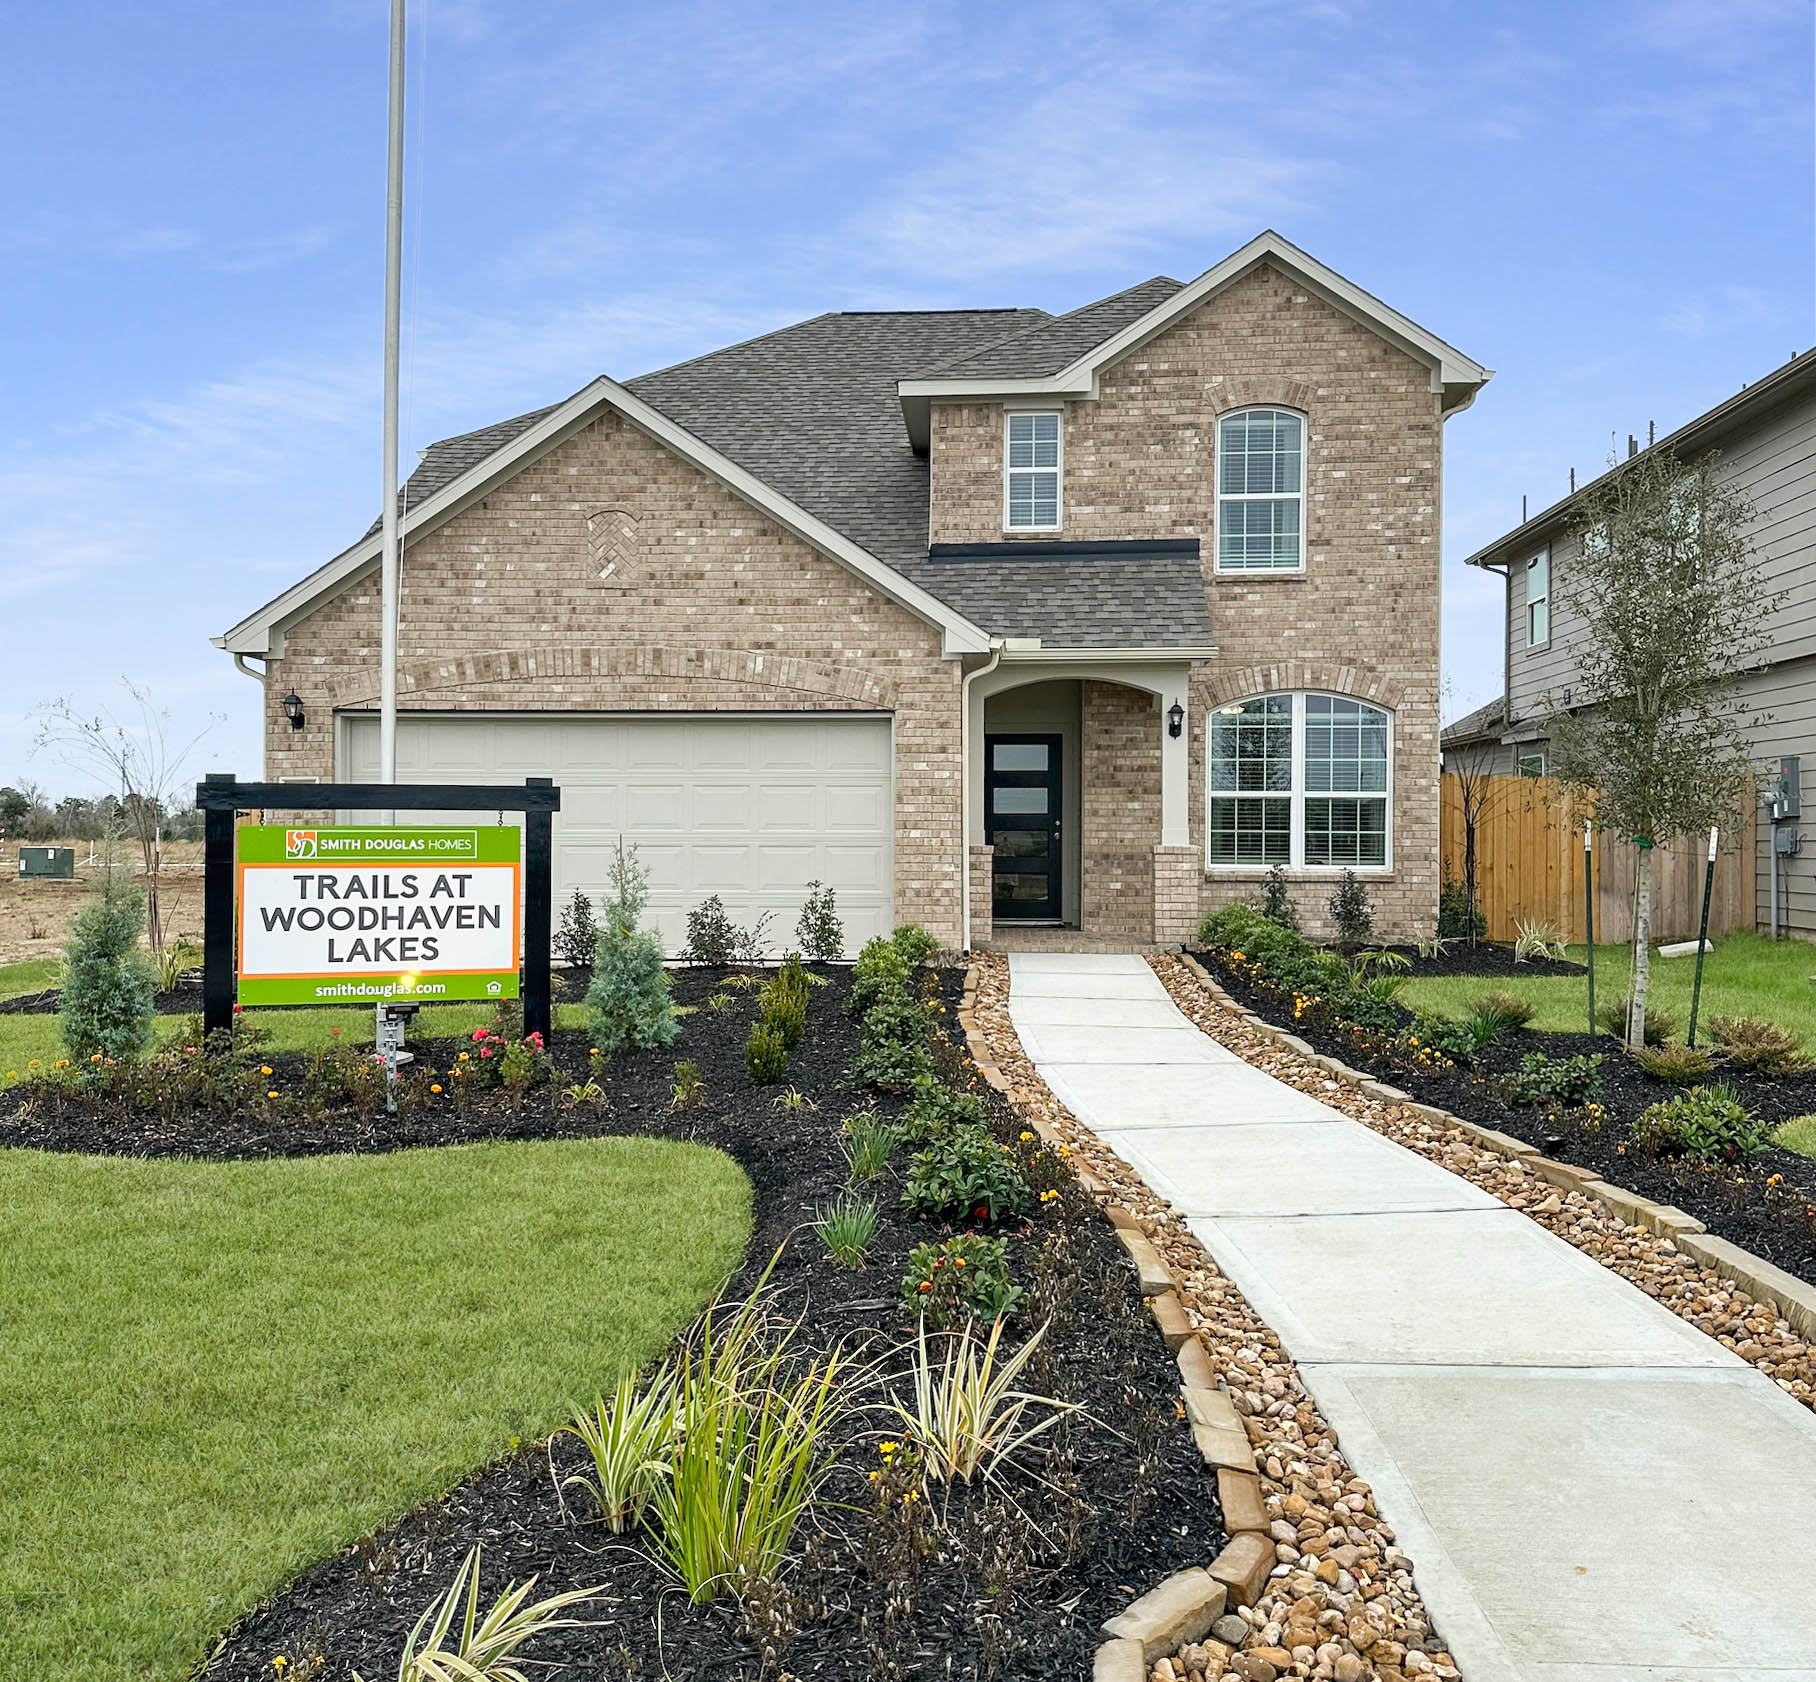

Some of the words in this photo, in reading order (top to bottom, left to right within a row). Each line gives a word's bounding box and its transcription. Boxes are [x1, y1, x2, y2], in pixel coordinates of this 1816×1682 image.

[320, 838, 361, 850] SMITH
[365, 838, 425, 850] DOUGLAS
[428, 838, 472, 850] HOMES
[293, 874, 419, 900] TRAILS
[429, 874, 473, 898] AT
[260, 905, 501, 932] WOODHAVEN
[327, 937, 440, 963] LAKES
[315, 982, 446, 997] smithdouglas.com
